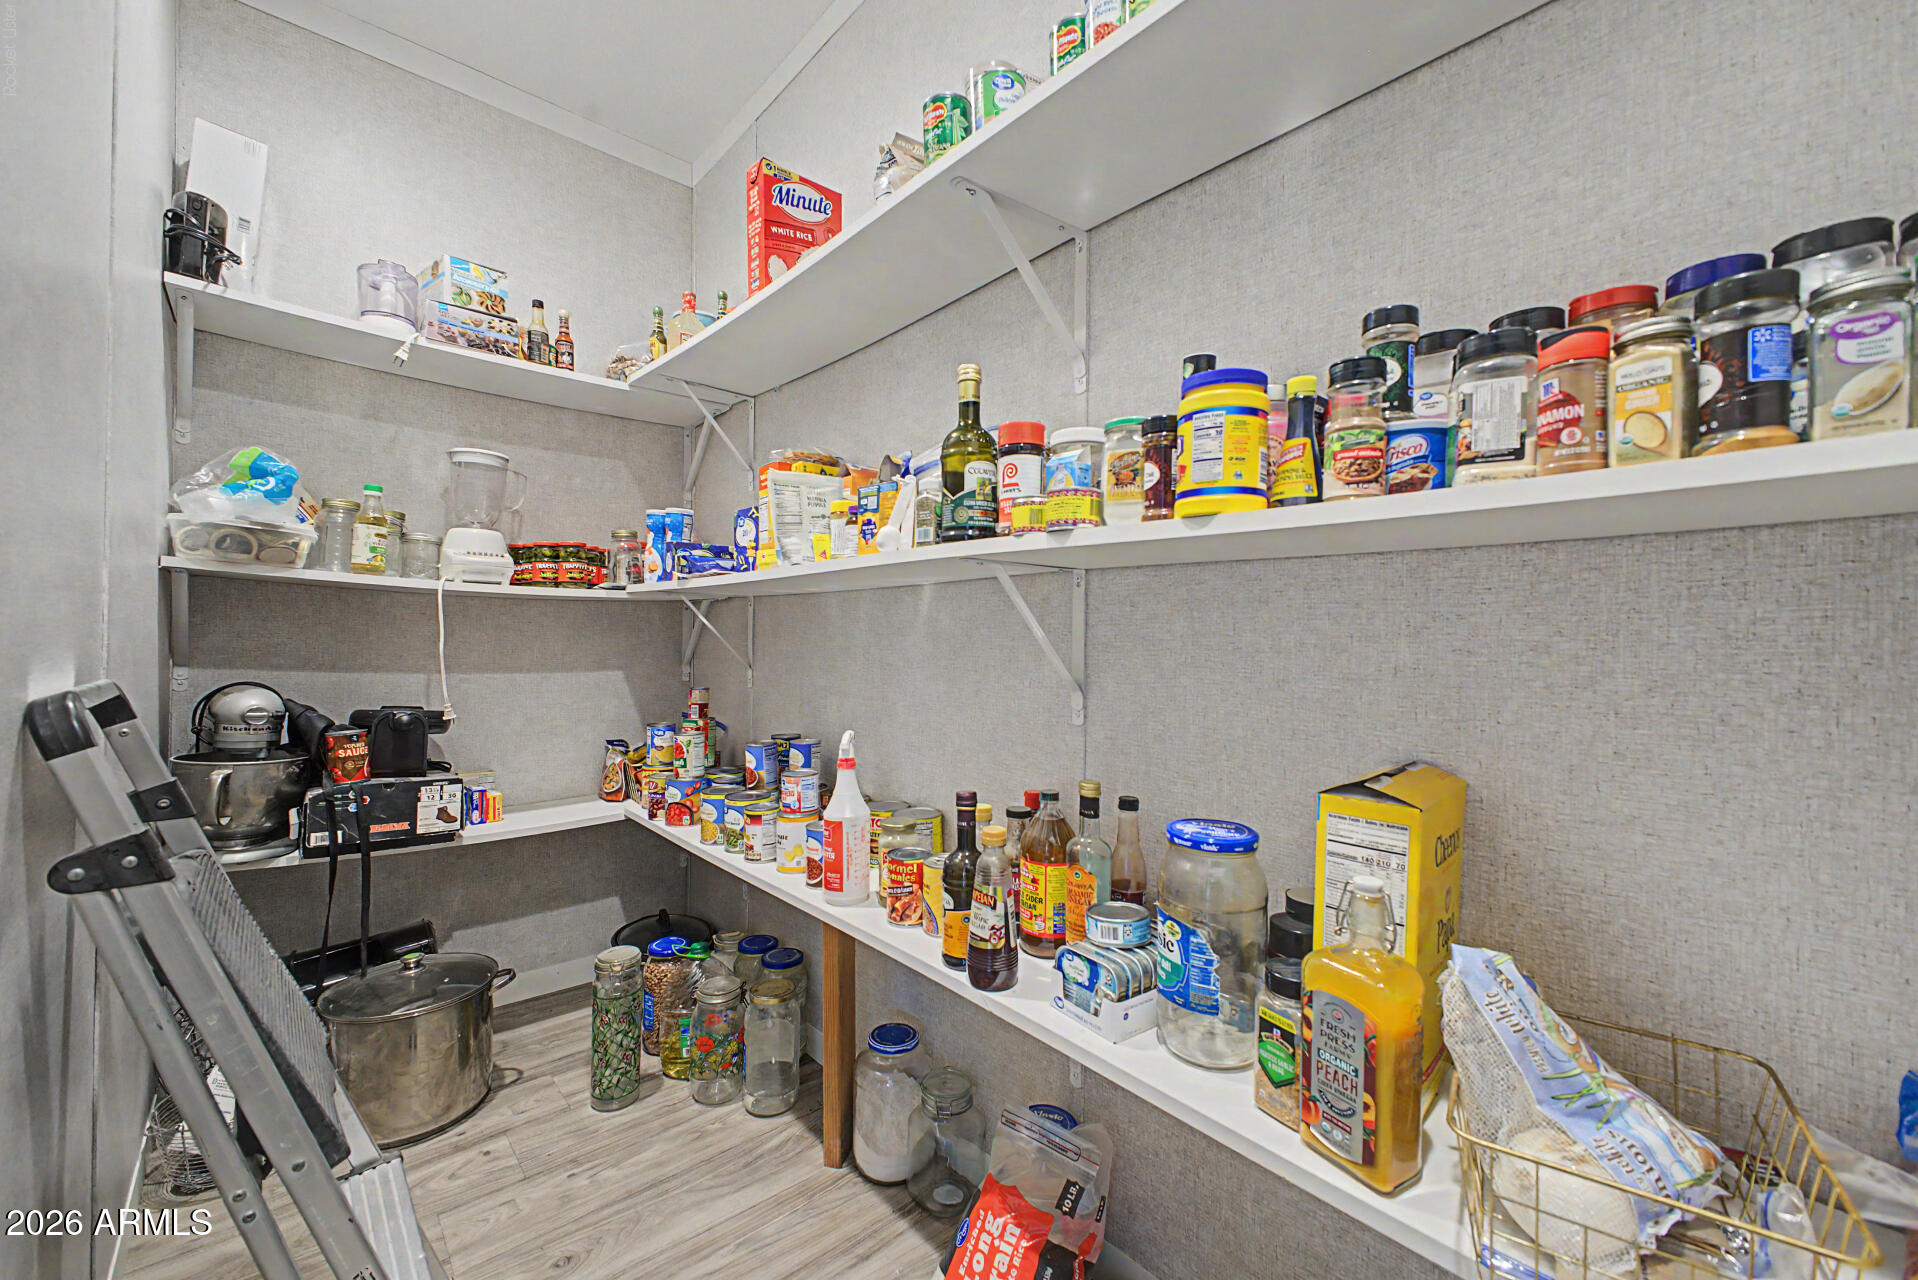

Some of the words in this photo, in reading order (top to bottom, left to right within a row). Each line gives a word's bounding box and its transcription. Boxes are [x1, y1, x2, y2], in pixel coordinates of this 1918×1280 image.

[772, 185, 832, 216] Minute
[770, 225, 795, 239] WHITE
[796, 229, 813, 242] RICE
[222, 724, 279, 733] KitchenA
[888, 862, 918, 874] ormel
[1320, 1017, 1357, 1044] FRESH
[1320, 1029, 1356, 1054] PRESS
[1319, 1048, 1357, 1076] ORGANIC
[1316, 1059, 1358, 1098] PEACH
[1605, 1129, 1672, 1199] nions
[1062, 1198, 1073, 1213] 10
[958, 1208, 985, 1277] Enriched
[989, 1223, 1022, 1280] rain
